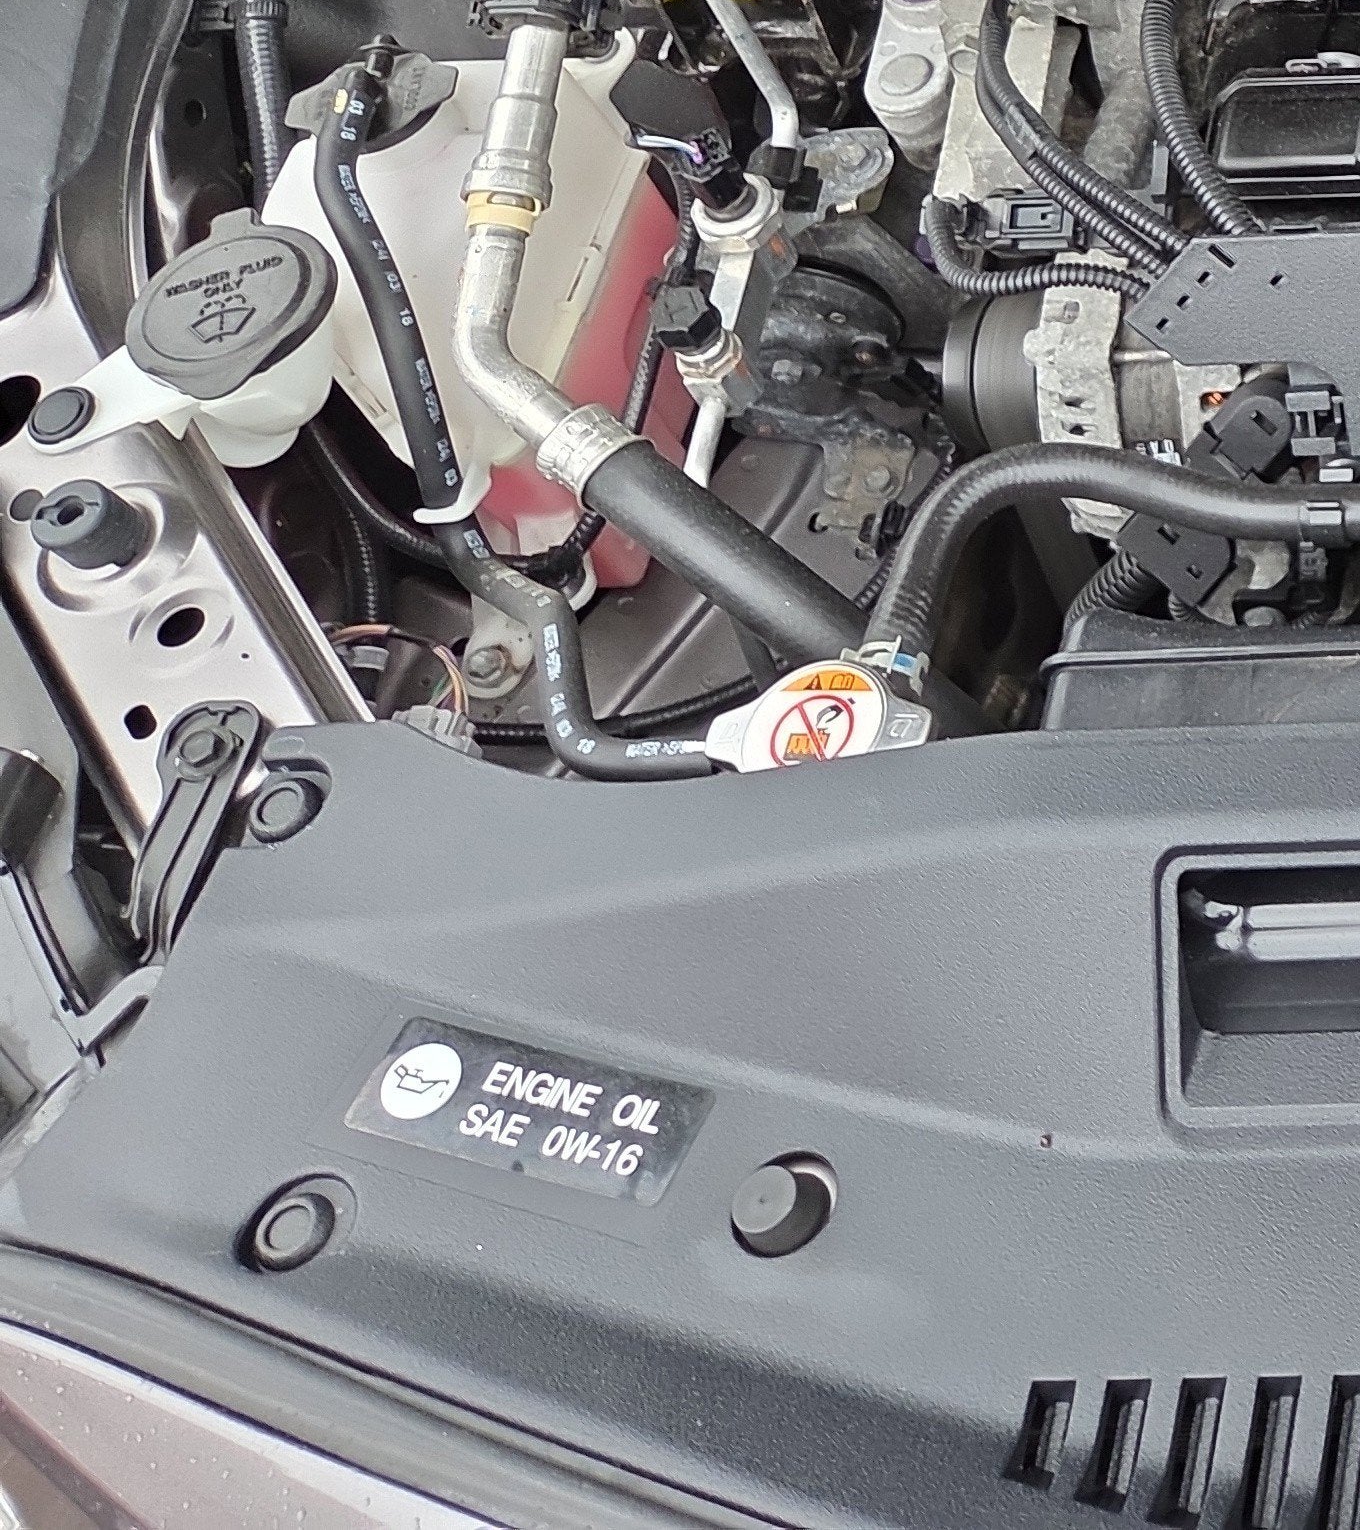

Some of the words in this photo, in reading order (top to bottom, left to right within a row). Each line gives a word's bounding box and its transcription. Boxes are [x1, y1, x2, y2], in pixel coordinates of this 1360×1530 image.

[165, 268, 232, 299] WASHER
[482, 1061, 603, 1117] ENGINE
[612, 1094, 660, 1135] OIL
[459, 1103, 531, 1148] SAE
[541, 1124, 644, 1177] 0W-16
